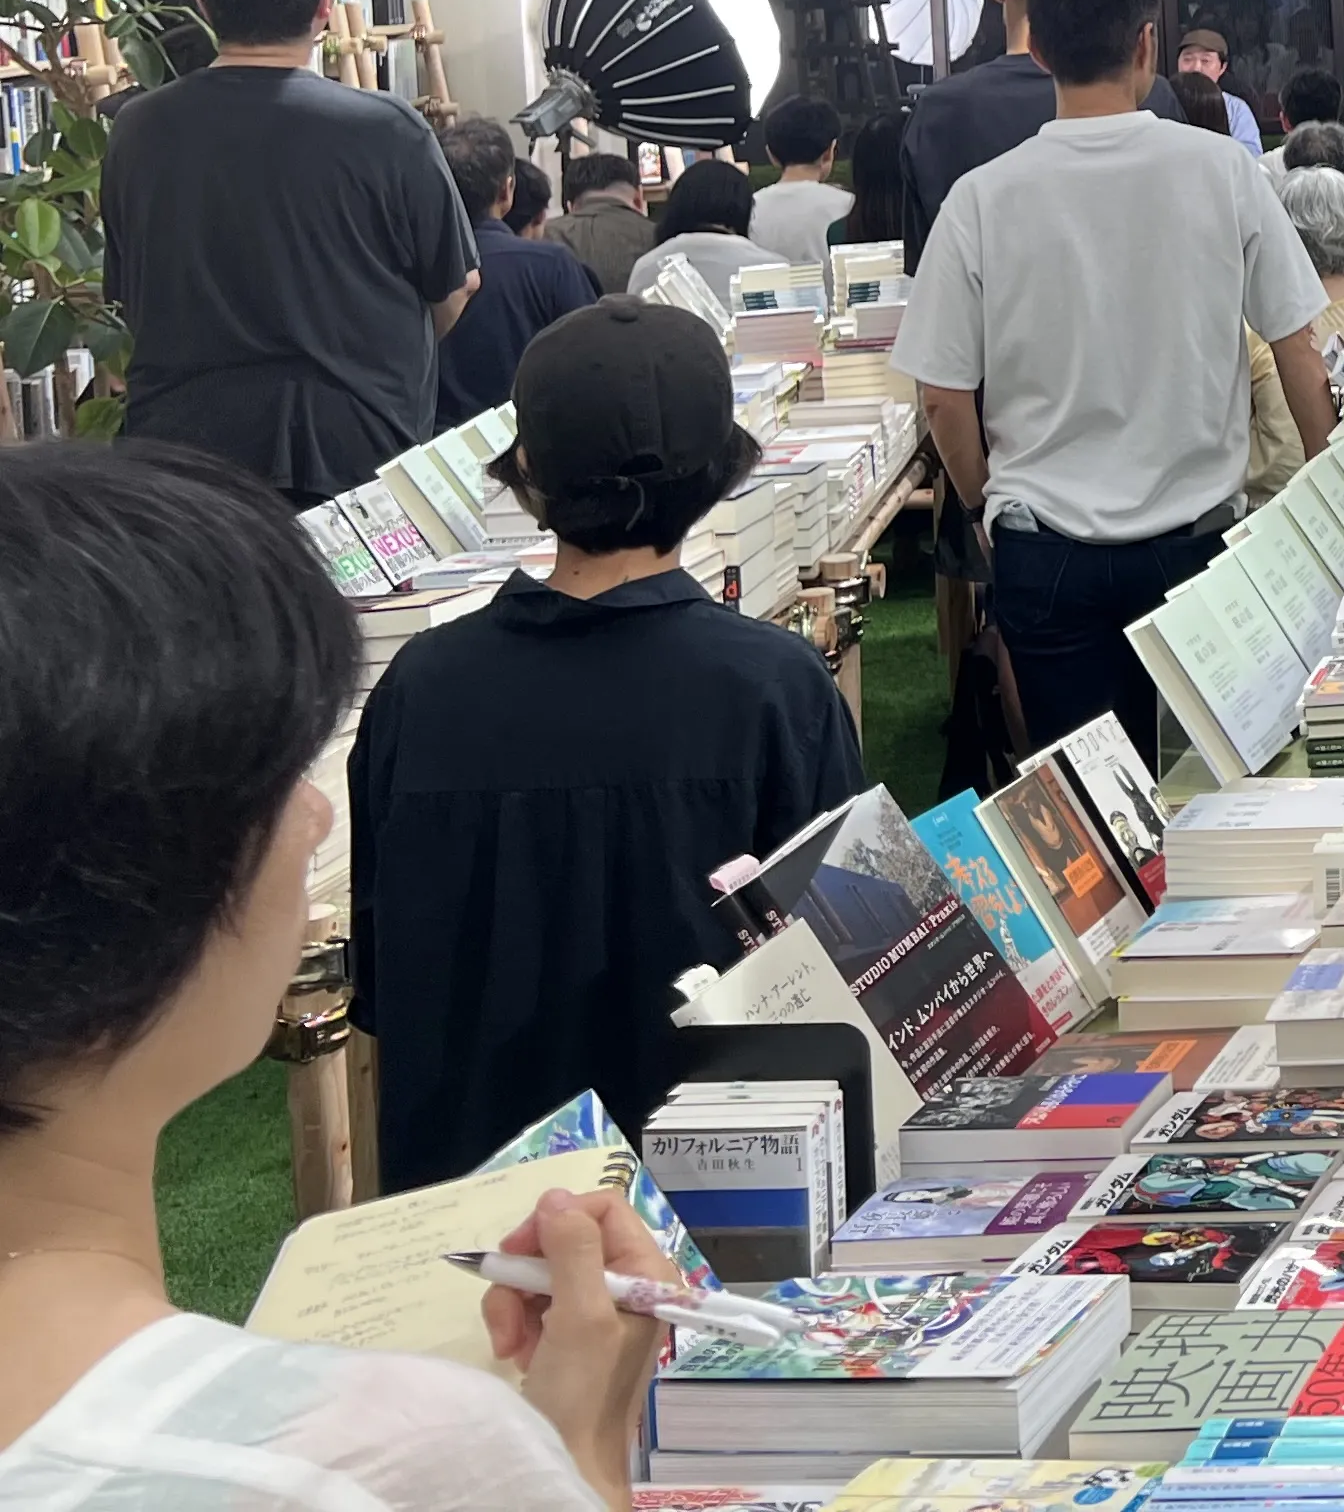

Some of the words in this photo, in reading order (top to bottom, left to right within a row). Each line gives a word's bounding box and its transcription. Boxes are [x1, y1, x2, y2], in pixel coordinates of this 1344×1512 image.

[370, 523, 422, 559] NEXUS
[850, 956, 892, 998] STUDIO
[888, 950, 994, 1051] インド、ムンバイから世界へ
[1158, 1106, 1194, 1137] ガンダム
[651, 1134, 799, 1156] カリフォルニア物語
[796, 1157, 803, 1172] 1
[1096, 1172, 1134, 1209] ガンダム
[1027, 1239, 1073, 1275] ガンダム
